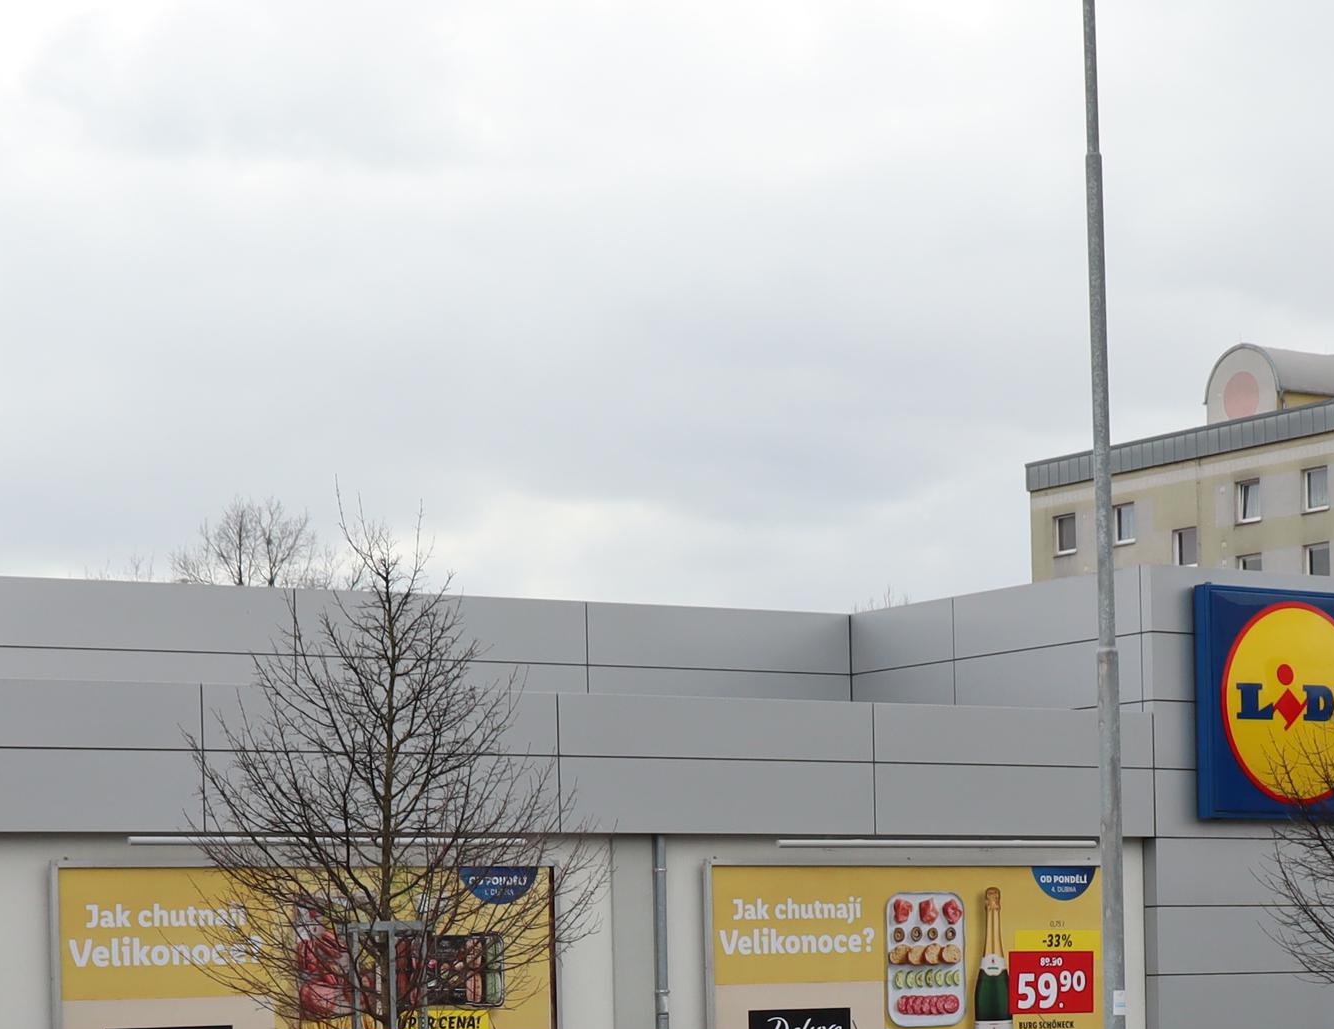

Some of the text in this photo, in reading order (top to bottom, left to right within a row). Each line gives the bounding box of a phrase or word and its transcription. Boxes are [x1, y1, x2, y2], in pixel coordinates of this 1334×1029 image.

[1040, 874, 1087, 883] OD PONDĚLÍ
[86, 904, 131, 928] Jak
[733, 896, 862, 924] Jak chutnají
[719, 927, 875, 955] Velikonoce?
[1042, 934, 1072, 947] -33%
[439, 1015, 481, 1029] CENA!
[1019, 1020, 1074, 1029] BURG SCHÖNECK
